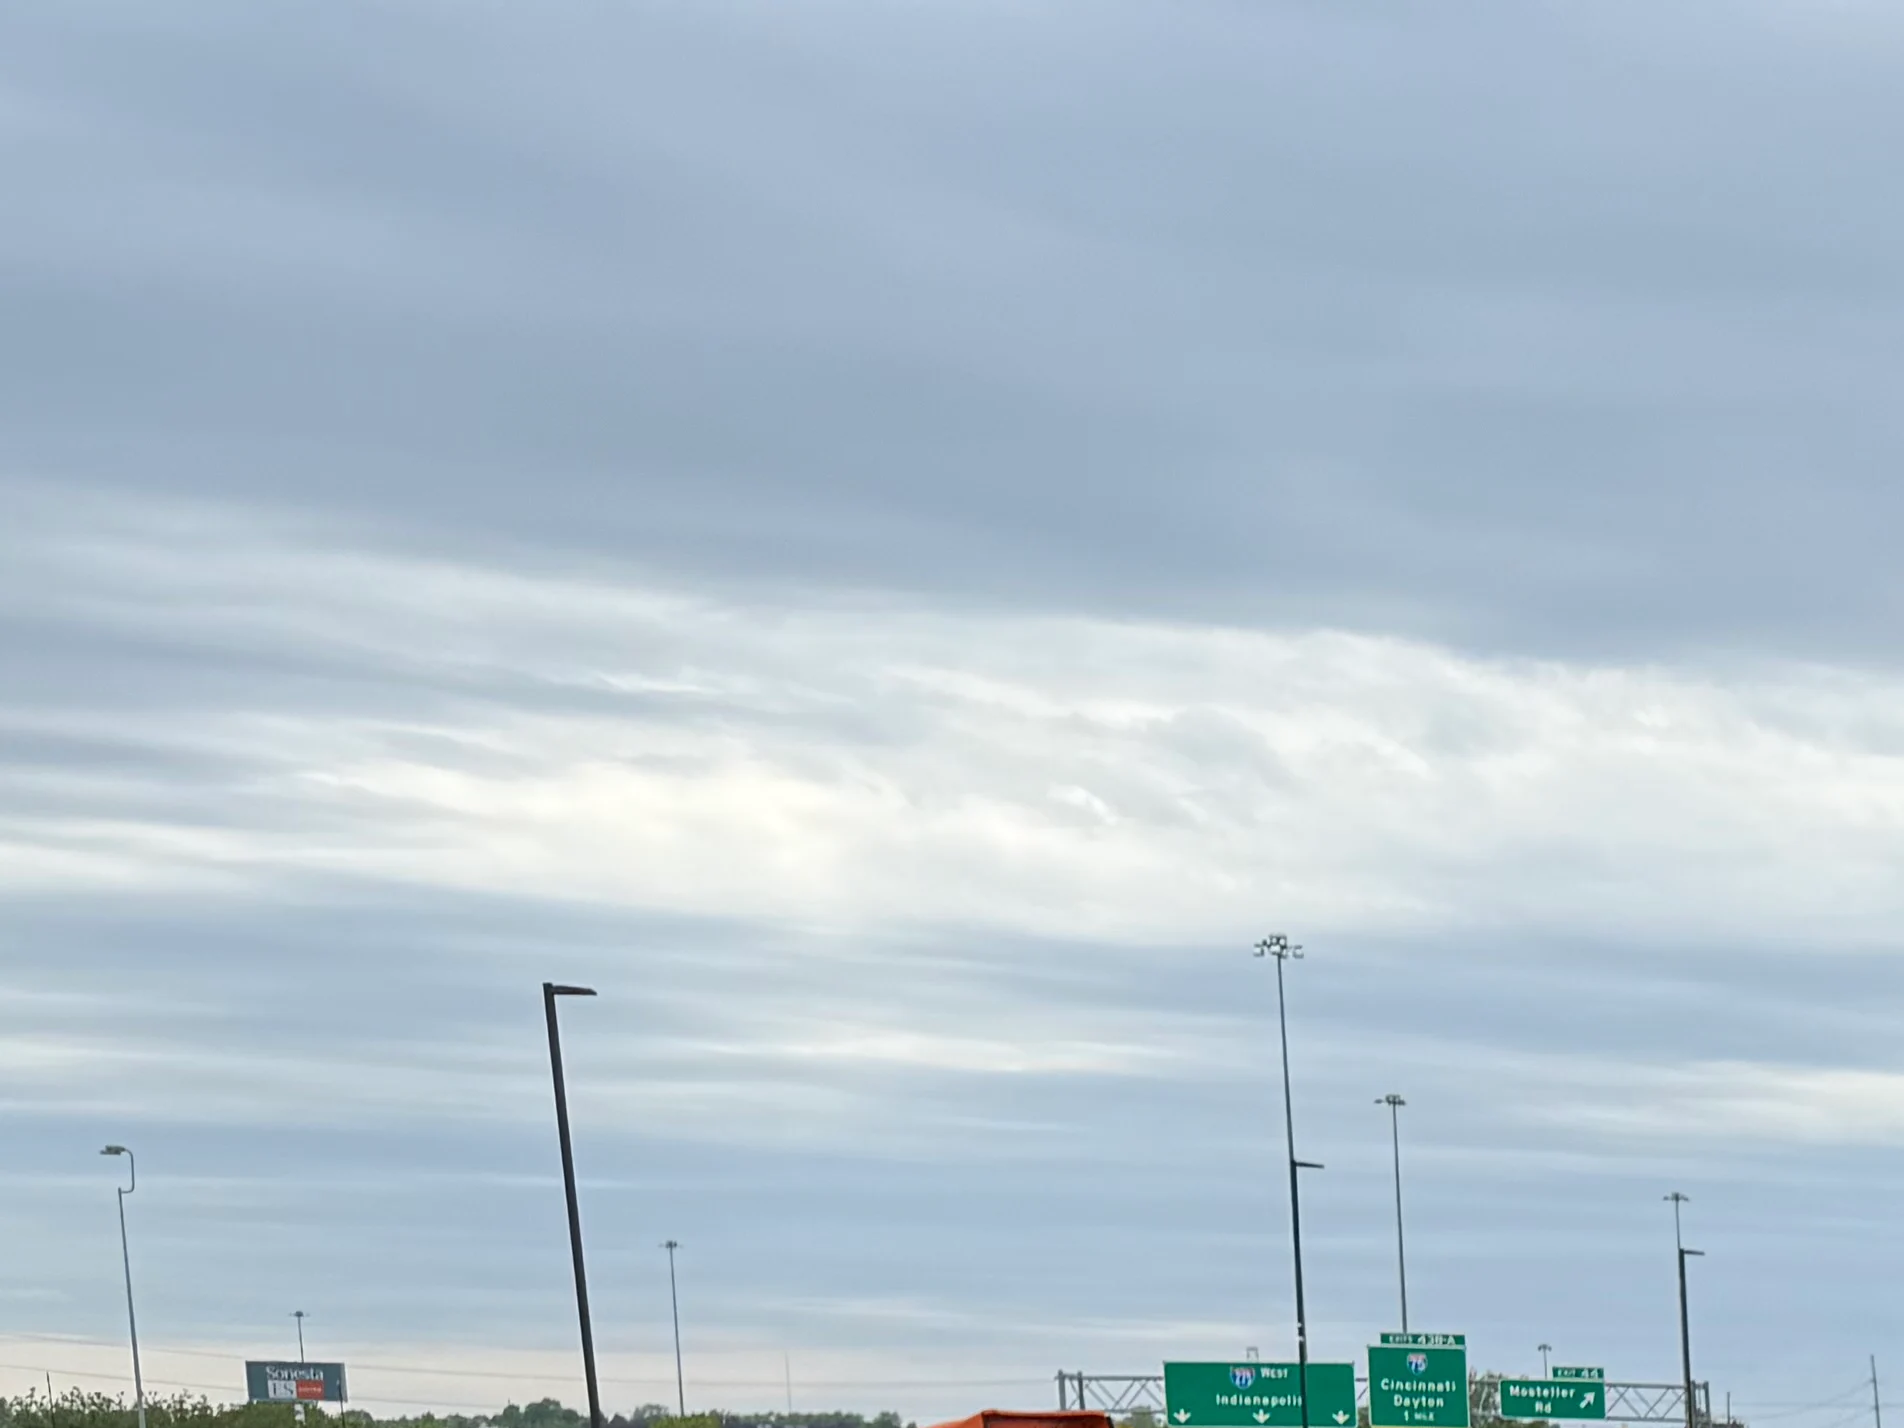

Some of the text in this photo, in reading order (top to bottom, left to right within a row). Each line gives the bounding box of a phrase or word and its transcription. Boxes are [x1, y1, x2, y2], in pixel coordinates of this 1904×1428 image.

[266, 1365, 324, 1380] Sonesta
[1381, 1378, 1456, 1393] Cincinnati
[1510, 1385, 1576, 1399] Mosteller
[1394, 1394, 1444, 1409] Dayton
[1535, 1401, 1552, 1414] Rd
[1404, 1410, 1409, 1422] 1
